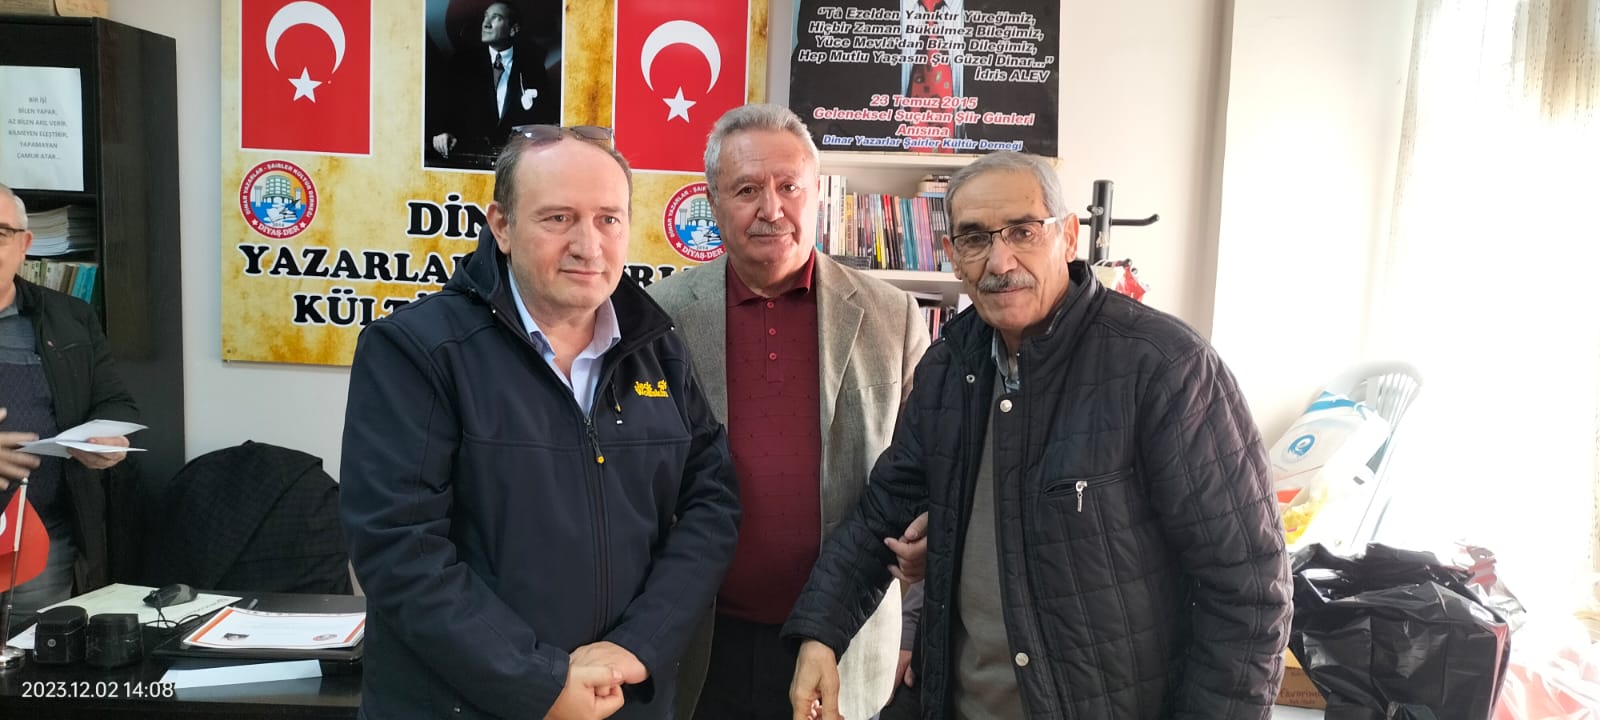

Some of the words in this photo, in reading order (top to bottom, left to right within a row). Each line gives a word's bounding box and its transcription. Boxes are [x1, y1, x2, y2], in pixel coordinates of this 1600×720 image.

[846, 7, 900, 20] Ezelden
[905, 10, 959, 21] Yanıktır
[964, 11, 1036, 26] Yüreğimiz,
[808, 21, 852, 35] Hiçbir
[853, 22, 901, 34] Zaman
[905, 24, 973, 37] Bükülmez
[975, 26, 1044, 41] Bileğimiz,
[815, 35, 851, 47] Yüce
[927, 38, 966, 50] Bizim
[968, 40, 1037, 55] Dileğimiz,
[798, 49, 827, 64] Hep
[829, 50, 870, 62] Mutlu
[873, 51, 928, 65] Yaşasın
[931, 53, 950, 67] Şu
[954, 54, 993, 66] Güzel
[974, 66, 1008, 81] İdris
[1009, 69, 1050, 82] ALEV
[870, 95, 889, 107] 23
[892, 95, 940, 107] Temuz
[941, 96, 978, 109] 2015
[813, 107, 892, 121] Geleneksel
[895, 110, 952, 124] Suçıkan
[955, 111, 981, 125] Şiir
[982, 112, 1035, 125] Günleri
[895, 124, 950, 137] Anısına
[822, 135, 854, 145] Dinar
[855, 136, 901, 147] Yazarlar
[903, 138, 940, 149] Şairler
[942, 139, 978, 149] Kültür
[979, 139, 1023, 151] Derneği
[407, 195, 488, 238] DİN
[239, 245, 465, 283] YAZARLA
